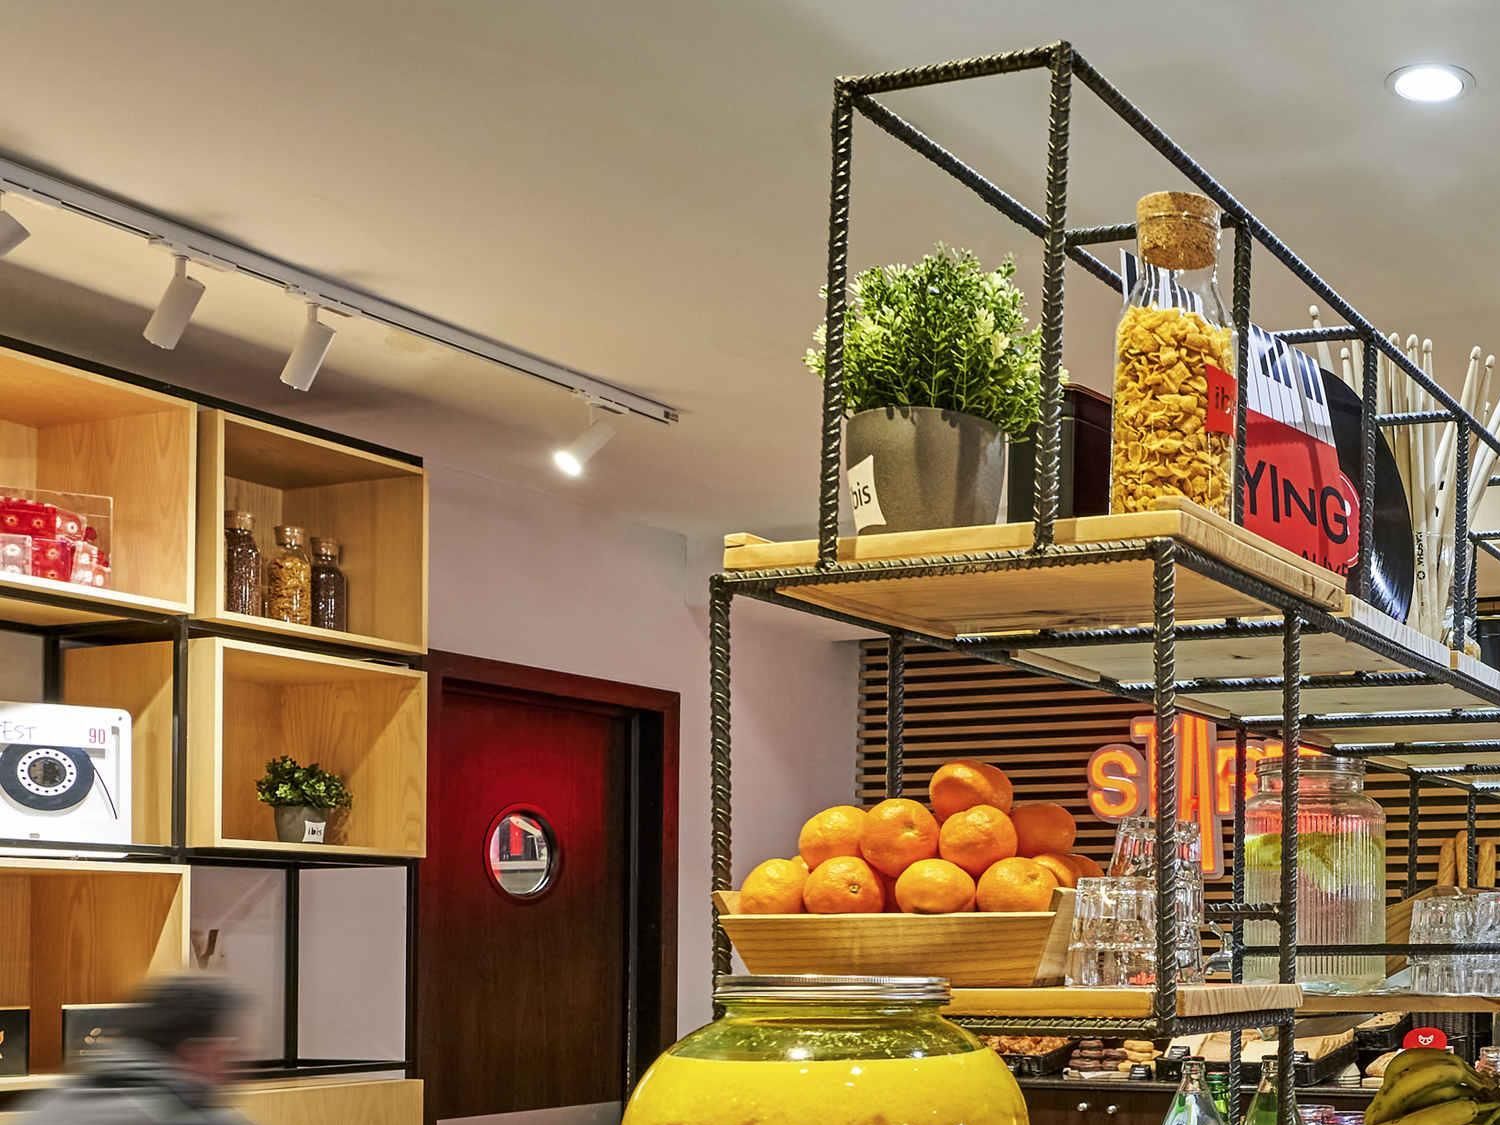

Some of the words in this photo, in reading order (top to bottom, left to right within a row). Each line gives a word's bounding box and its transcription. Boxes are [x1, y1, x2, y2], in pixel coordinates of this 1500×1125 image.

[1245, 460, 1348, 544] YING
[0, 720, 37, 741] EST
[88, 727, 106, 744] 90
[1090, 714, 1331, 872] STAR
